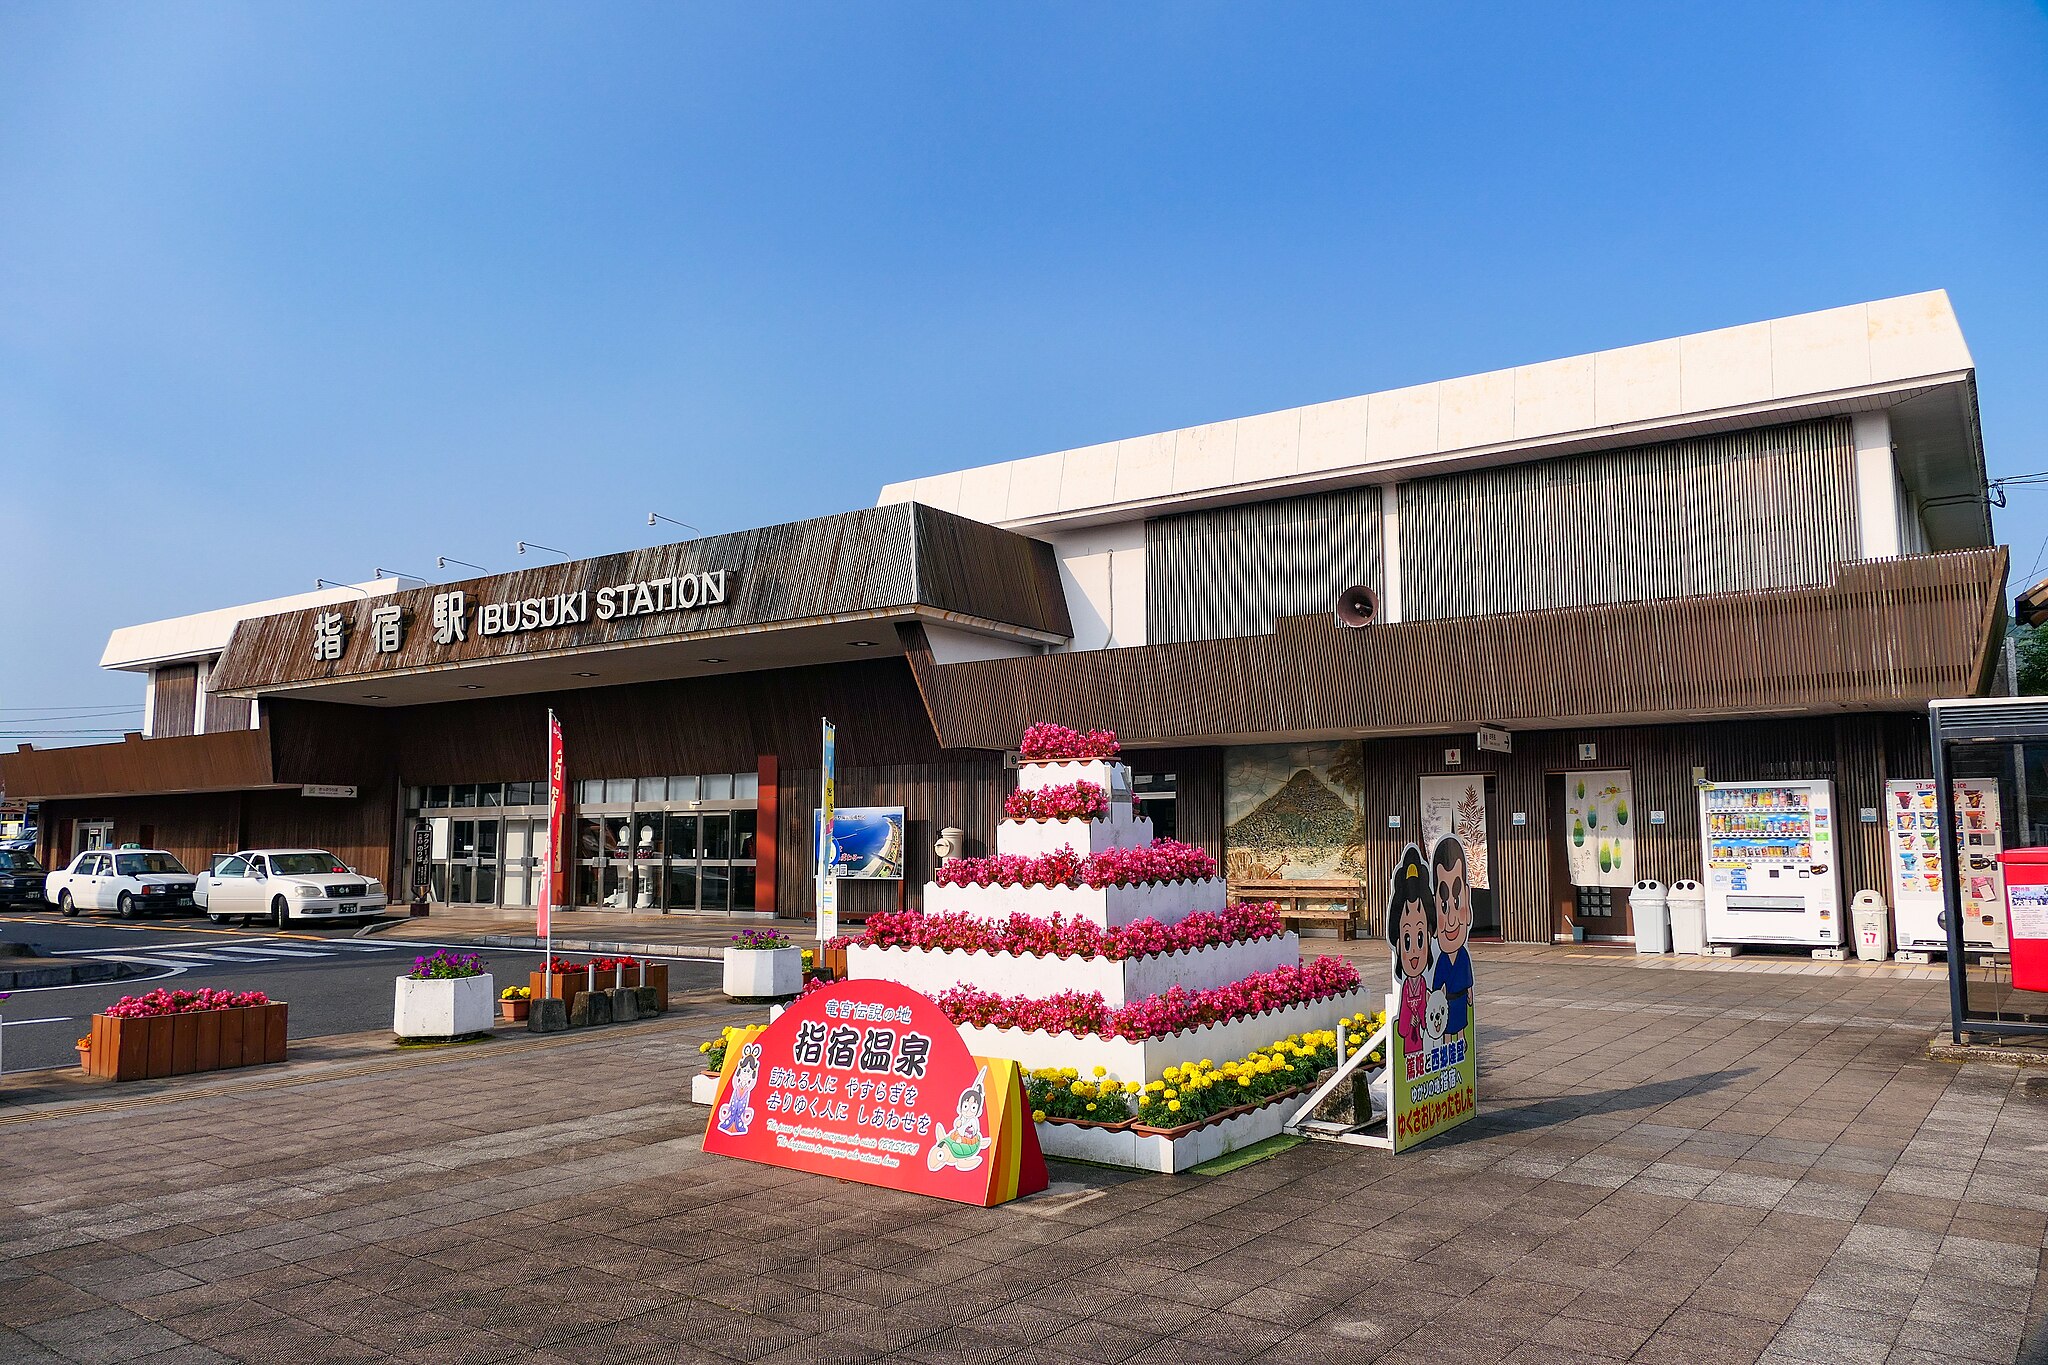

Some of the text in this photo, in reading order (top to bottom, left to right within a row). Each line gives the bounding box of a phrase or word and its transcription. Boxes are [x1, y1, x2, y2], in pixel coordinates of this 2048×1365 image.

[477, 570, 726, 637] IBUSUKI STATION
[314, 590, 467, 661] 指宿駅
[1957, 781, 1967, 789] ice
[825, 998, 912, 1024] 竜宮伝説の地
[794, 1020, 931, 1078] 指宿温泉
[769, 1067, 919, 1107] 訪れる人に やすらぎを
[766, 1091, 932, 1136] 去りゆく人に しあわせを
[1397, 1085, 1474, 1142] ゆくさおじゃったもした
[766, 1118, 777, 1131] The
[775, 1122, 793, 1134] peace
[793, 1123, 801, 1138] of
[800, 1125, 815, 1137] mind
[813, 1128, 822, 1138] to
[822, 1130, 847, 1145] everyone
[847, 1133, 860, 1145] who
[877, 1137, 920, 1156] IBUSUKI
[776, 1134, 900, 1168] The happiness to everyone who returns home
